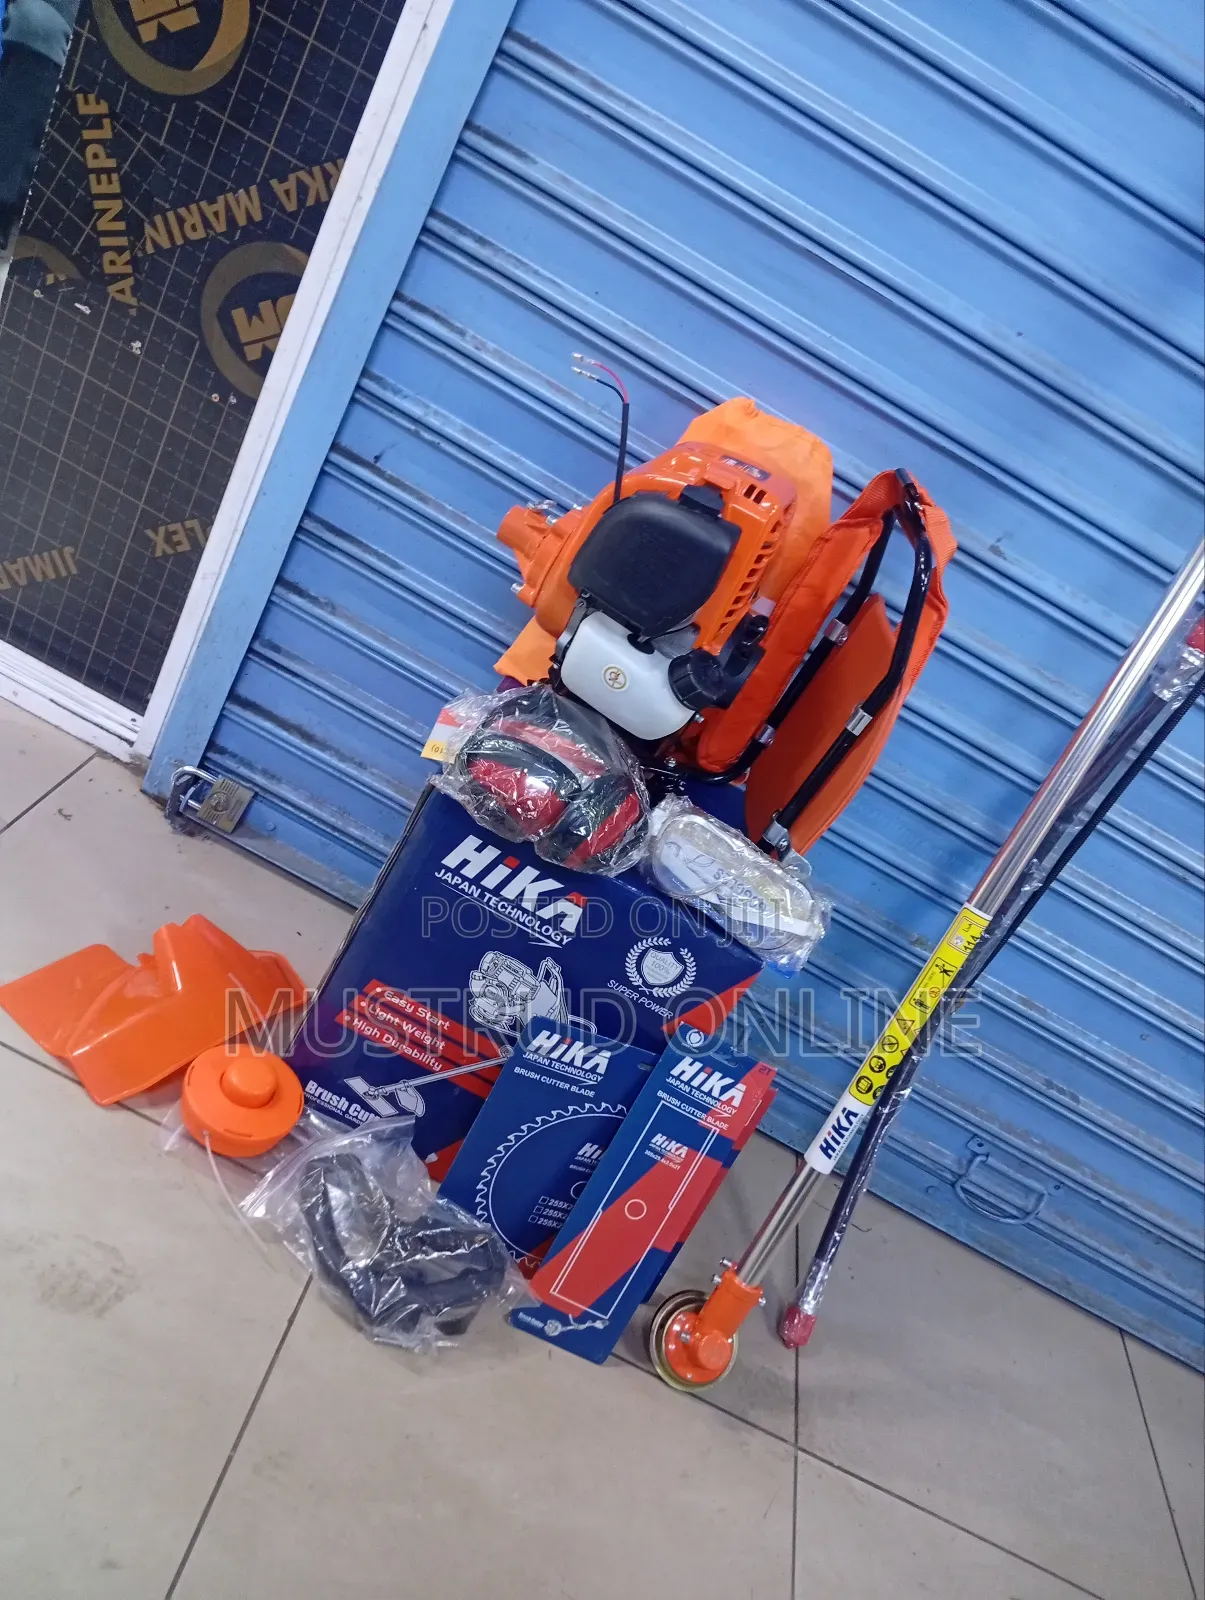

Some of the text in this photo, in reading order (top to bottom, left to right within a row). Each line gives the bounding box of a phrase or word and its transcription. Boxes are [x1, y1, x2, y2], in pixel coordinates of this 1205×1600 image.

[76, 93, 137, 316] ARINEPLE
[139, 184, 263, 255] MARIN
[434, 868, 573, 945] JAPAN TECHNOLOGY
[650, 952, 679, 970] QUALITY
[651, 960, 671, 975] 100%
[384, 990, 451, 1031] Easy Start
[607, 979, 674, 1019] SUPER POWER
[352, 1018, 443, 1072] High Durability
[369, 1004, 446, 1050] Light Weight
[514, 1066, 596, 1098] BRUSH CUTTER BLADE
[522, 1051, 604, 1083] JAPAN TECHNOLOGY
[304, 1079, 350, 1112] Brush
[656, 1089, 730, 1131] BRUSH CUTTER BLADE
[665, 1075, 738, 1115] JAPAN TECHNOLOGY
